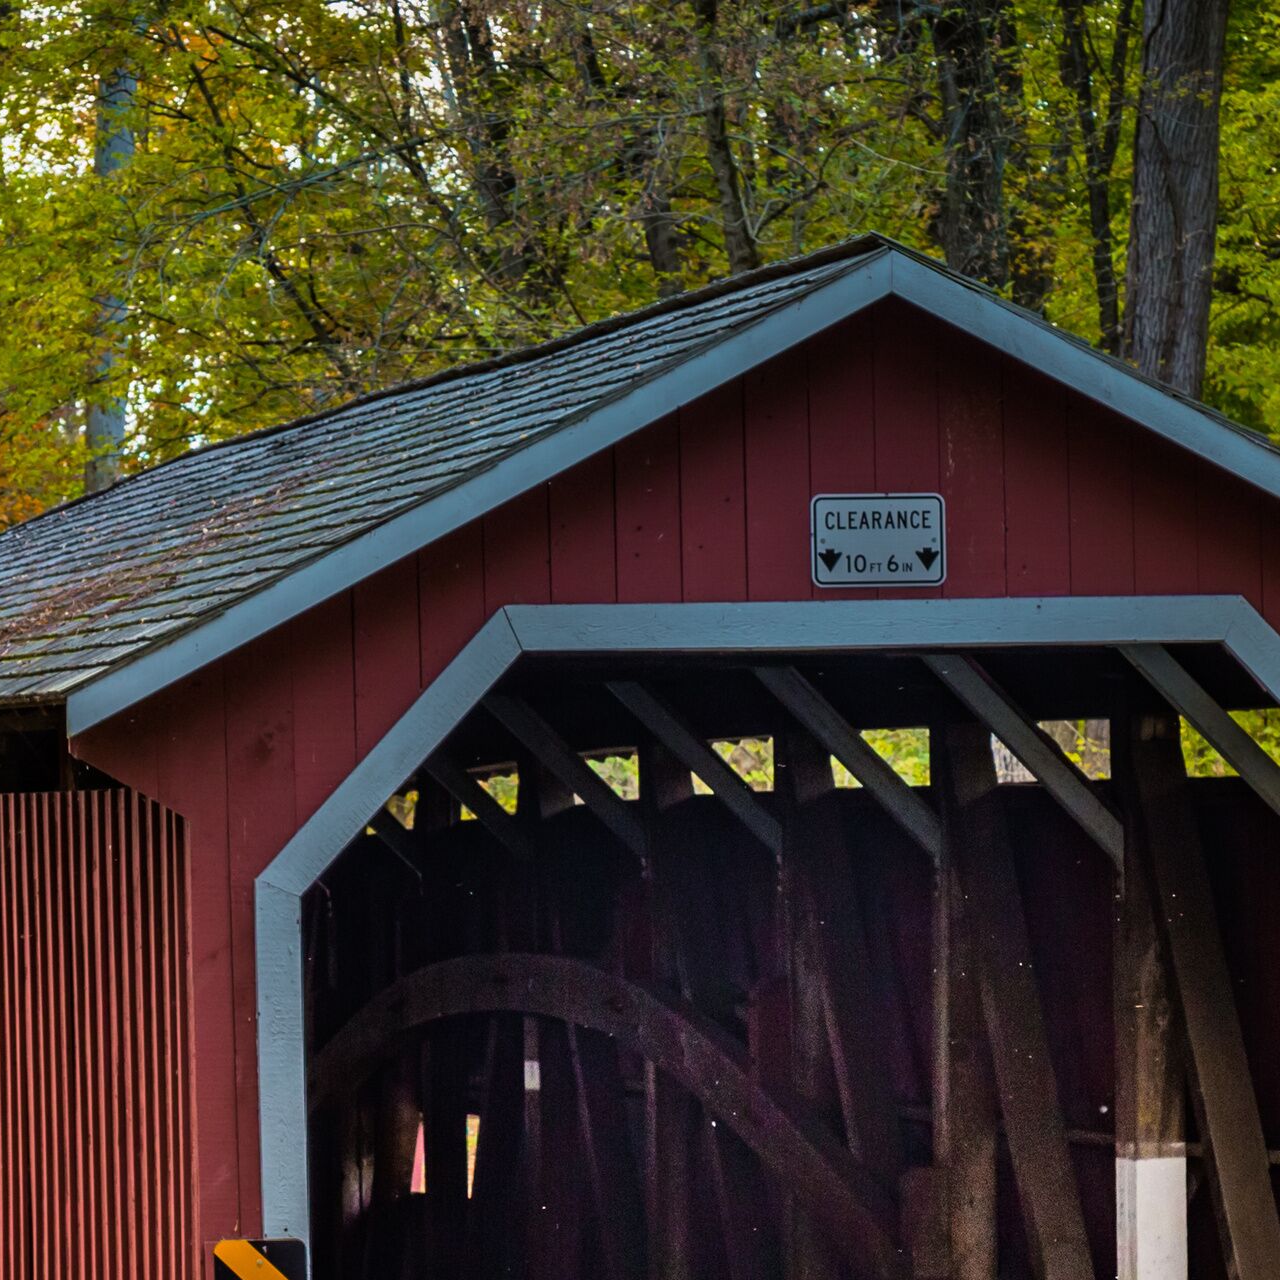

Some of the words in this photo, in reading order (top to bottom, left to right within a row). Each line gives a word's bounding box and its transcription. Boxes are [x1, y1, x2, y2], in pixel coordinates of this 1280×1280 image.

[824, 510, 932, 530] CLEARANCE
[846, 554, 867, 573] 10
[870, 562, 882, 573] FT
[887, 554, 899, 573] 6
[902, 562, 913, 573] IN
